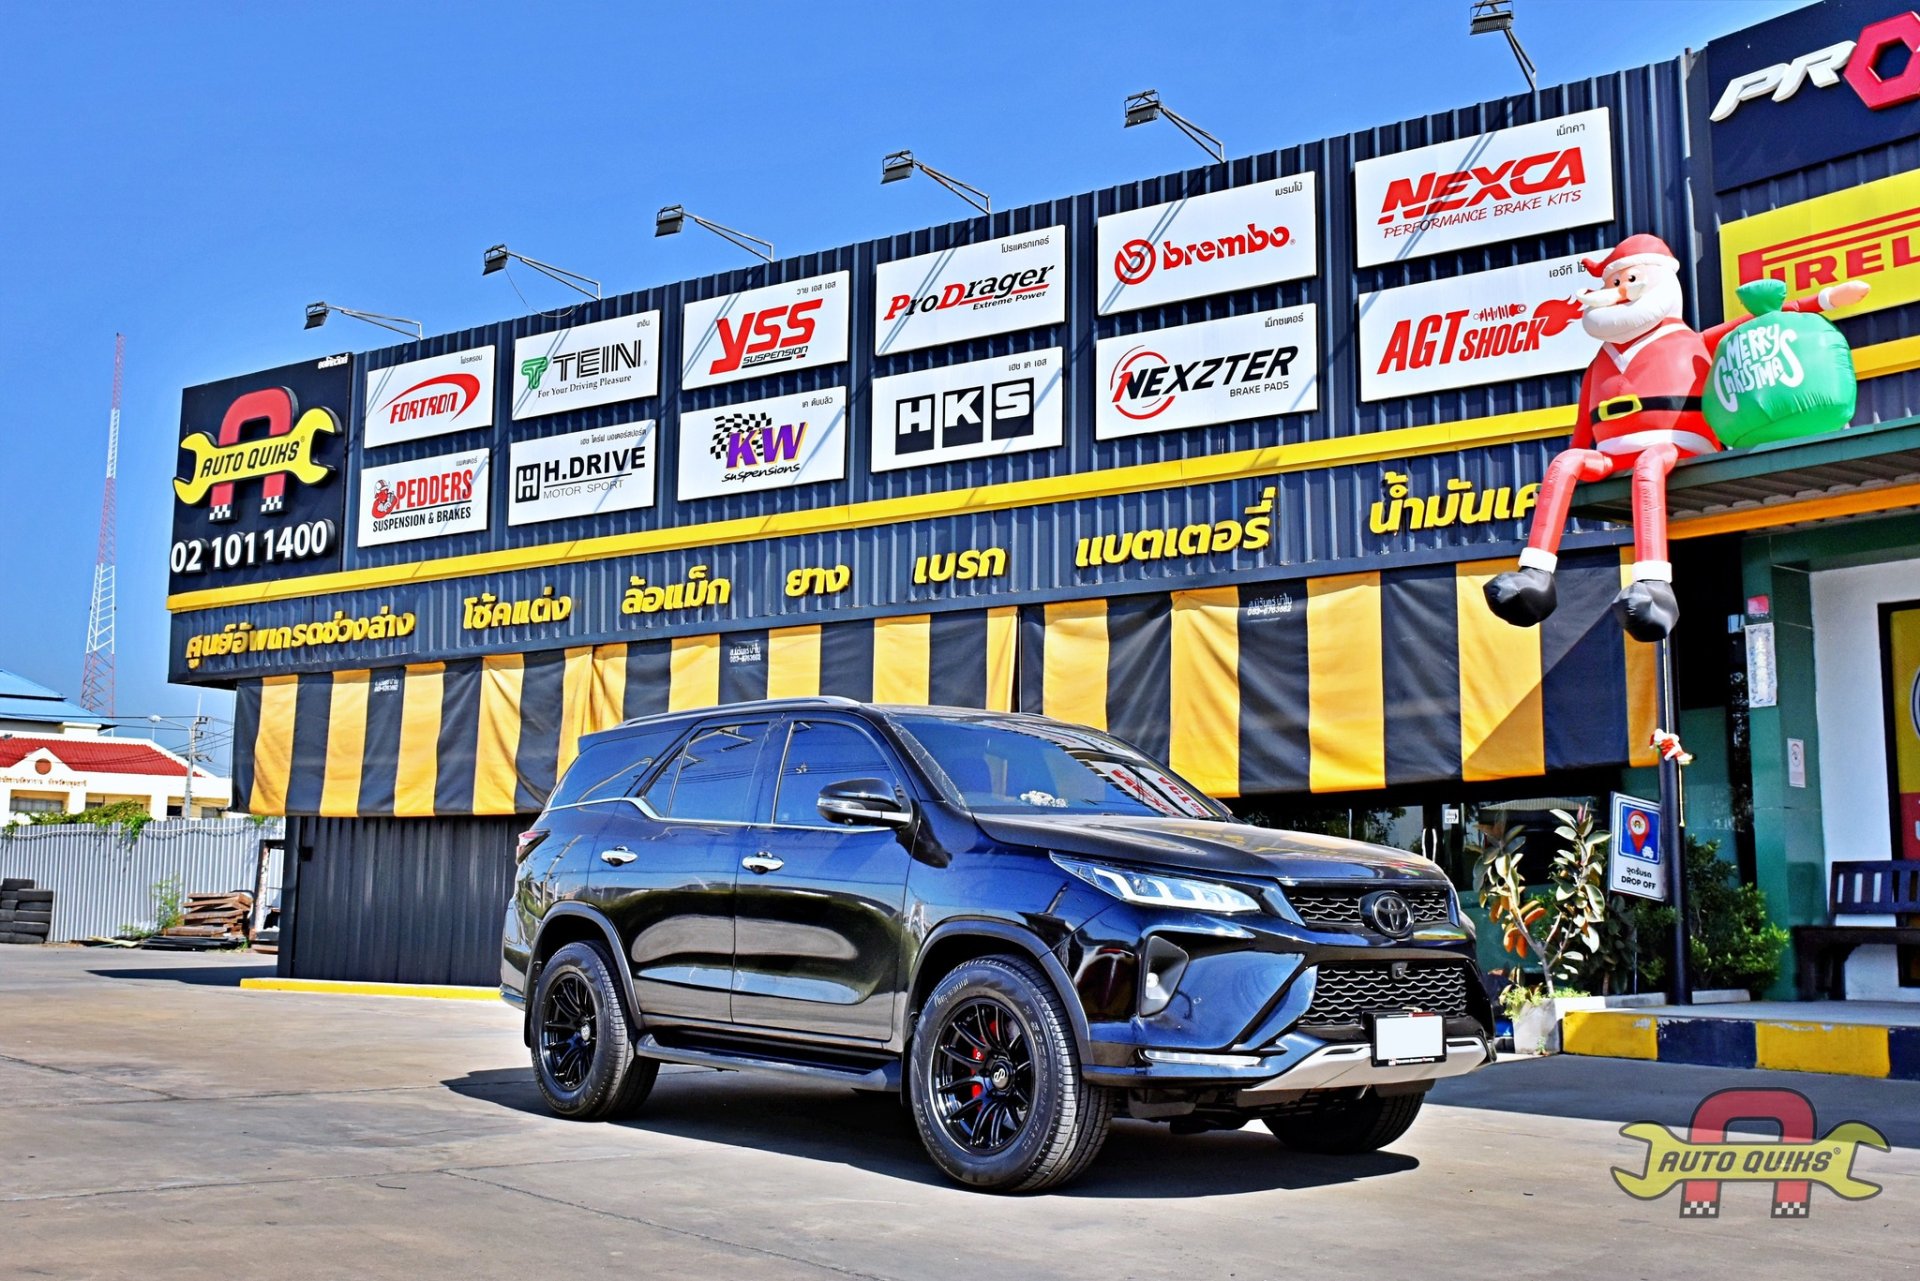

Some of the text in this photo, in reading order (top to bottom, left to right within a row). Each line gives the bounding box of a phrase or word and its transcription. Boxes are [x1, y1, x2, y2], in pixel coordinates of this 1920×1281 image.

[1377, 147, 1586, 225] NEXCA
[1383, 189, 1583, 239] PERFORMANCE BRAKE KITS
[1163, 223, 1291, 270] brembo
[884, 265, 1055, 321] ProDrager
[972, 291, 1047, 311] Extreme Power
[709, 298, 824, 376] YSS
[1376, 309, 1548, 375] AGT SHOCK
[552, 340, 642, 382] TEIN
[1112, 345, 1299, 403] NEXZTER
[390, 391, 458, 424] FORTRON
[537, 374, 632, 399] For Your Driving Pleasure
[1229, 380, 1290, 398] BRAKE PADS
[897, 379, 1032, 442] HKS
[199, 440, 301, 479] AUTO QUIKS
[544, 446, 647, 482] H.DRIVE
[726, 421, 806, 469] KW
[396, 469, 473, 510] PEDDERS
[543, 479, 625, 500] MOTOR SPORT
[721, 463, 801, 483] suspensions
[372, 506, 472, 533] SUSPENSION & BRAKES
[170, 520, 329, 574] 02 101 1400
[185, 606, 416, 669] ศูนย์อัพเกรดช่วงล่าง
[463, 586, 573, 630] โช้คแต่ง
[621, 565, 731, 615] ล้อแม็ก
[784, 564, 851, 598] ยาง
[914, 547, 1008, 585] เบรก
[1074, 487, 1277, 568] แบตเตอรี่
[1621, 875, 1657, 890] DROP OFF
